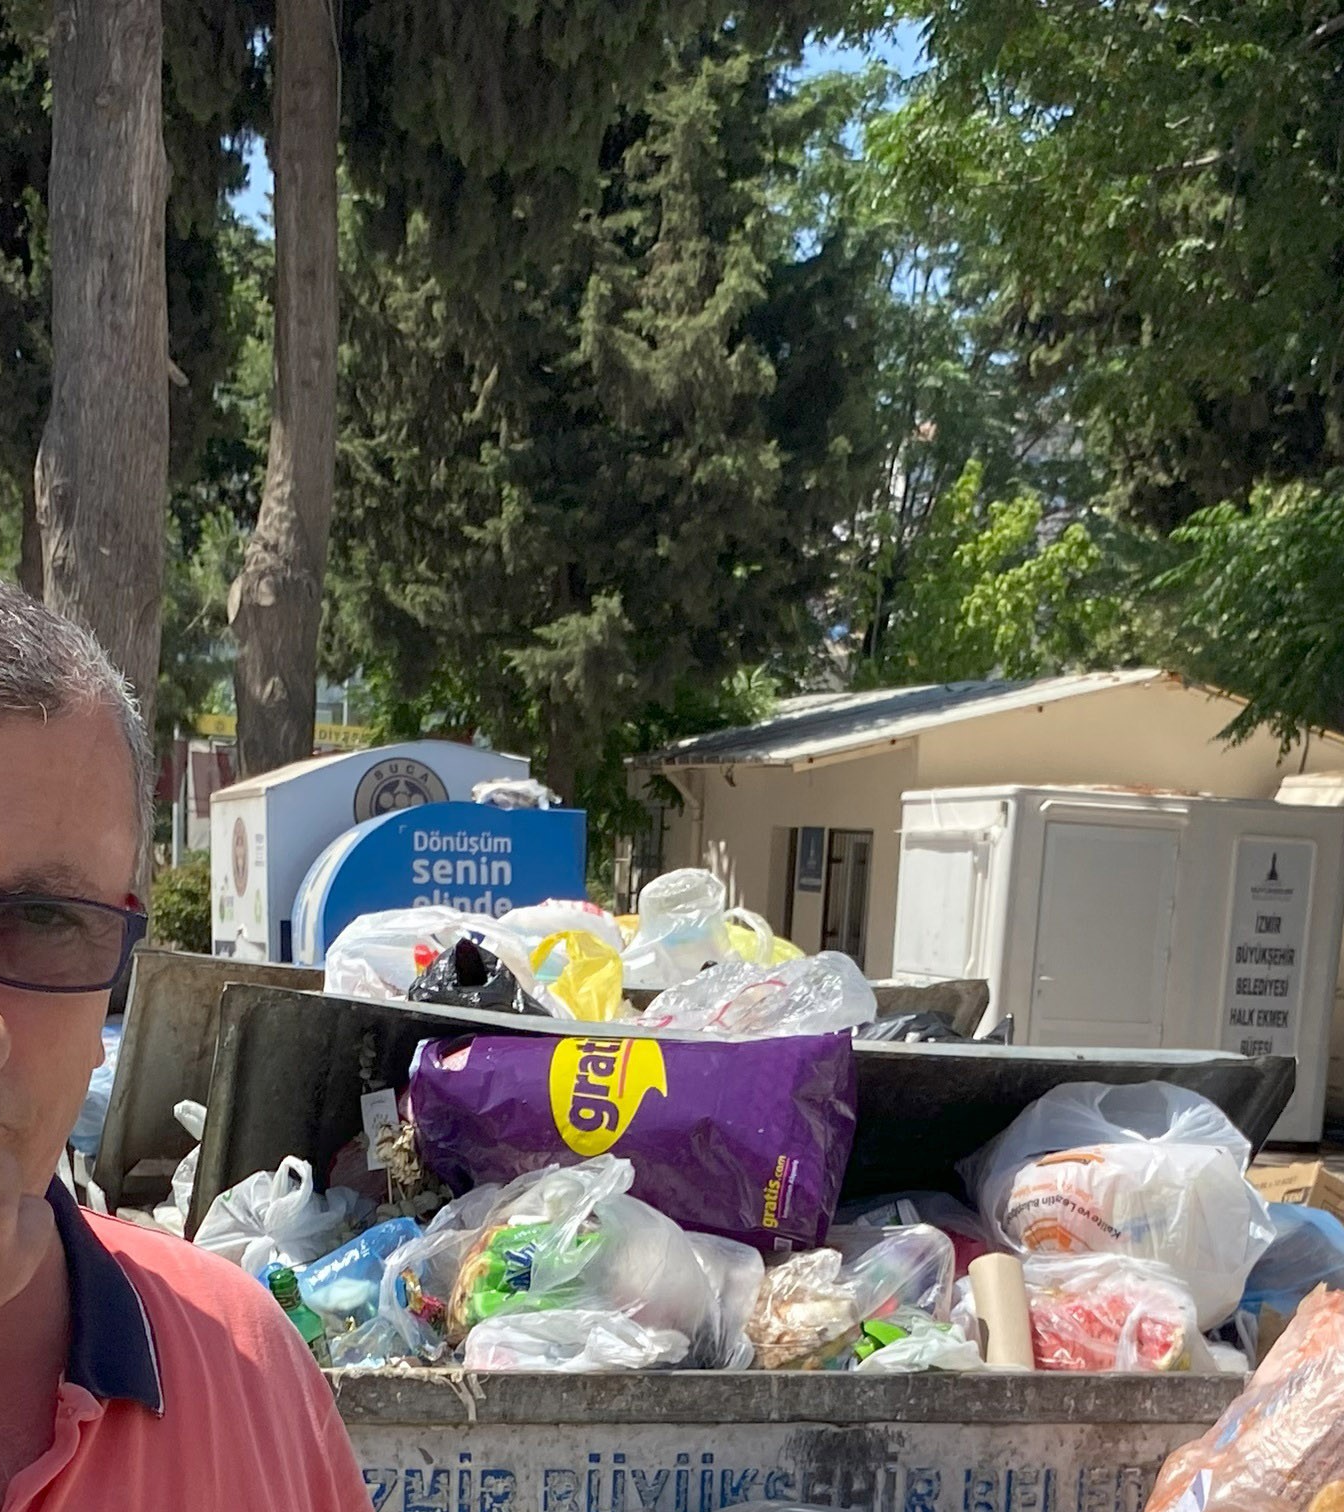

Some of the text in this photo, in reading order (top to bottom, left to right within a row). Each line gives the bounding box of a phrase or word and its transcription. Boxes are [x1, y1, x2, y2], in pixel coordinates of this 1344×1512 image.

[374, 763, 430, 782] BUCA
[413, 830, 512, 855] Dönüşüm
[412, 856, 512, 886] senin
[1255, 912, 1282, 935] İZMİR
[1235, 943, 1295, 969] BÜYÜKŞEHİR
[1235, 974, 1289, 997] BELEDİYESİ
[1229, 1008, 1289, 1029] HALK EKMEK
[568, 1038, 620, 1132] grat
[762, 1155, 787, 1229] gratis.com
[1091, 1215, 1122, 1240] Kalite
